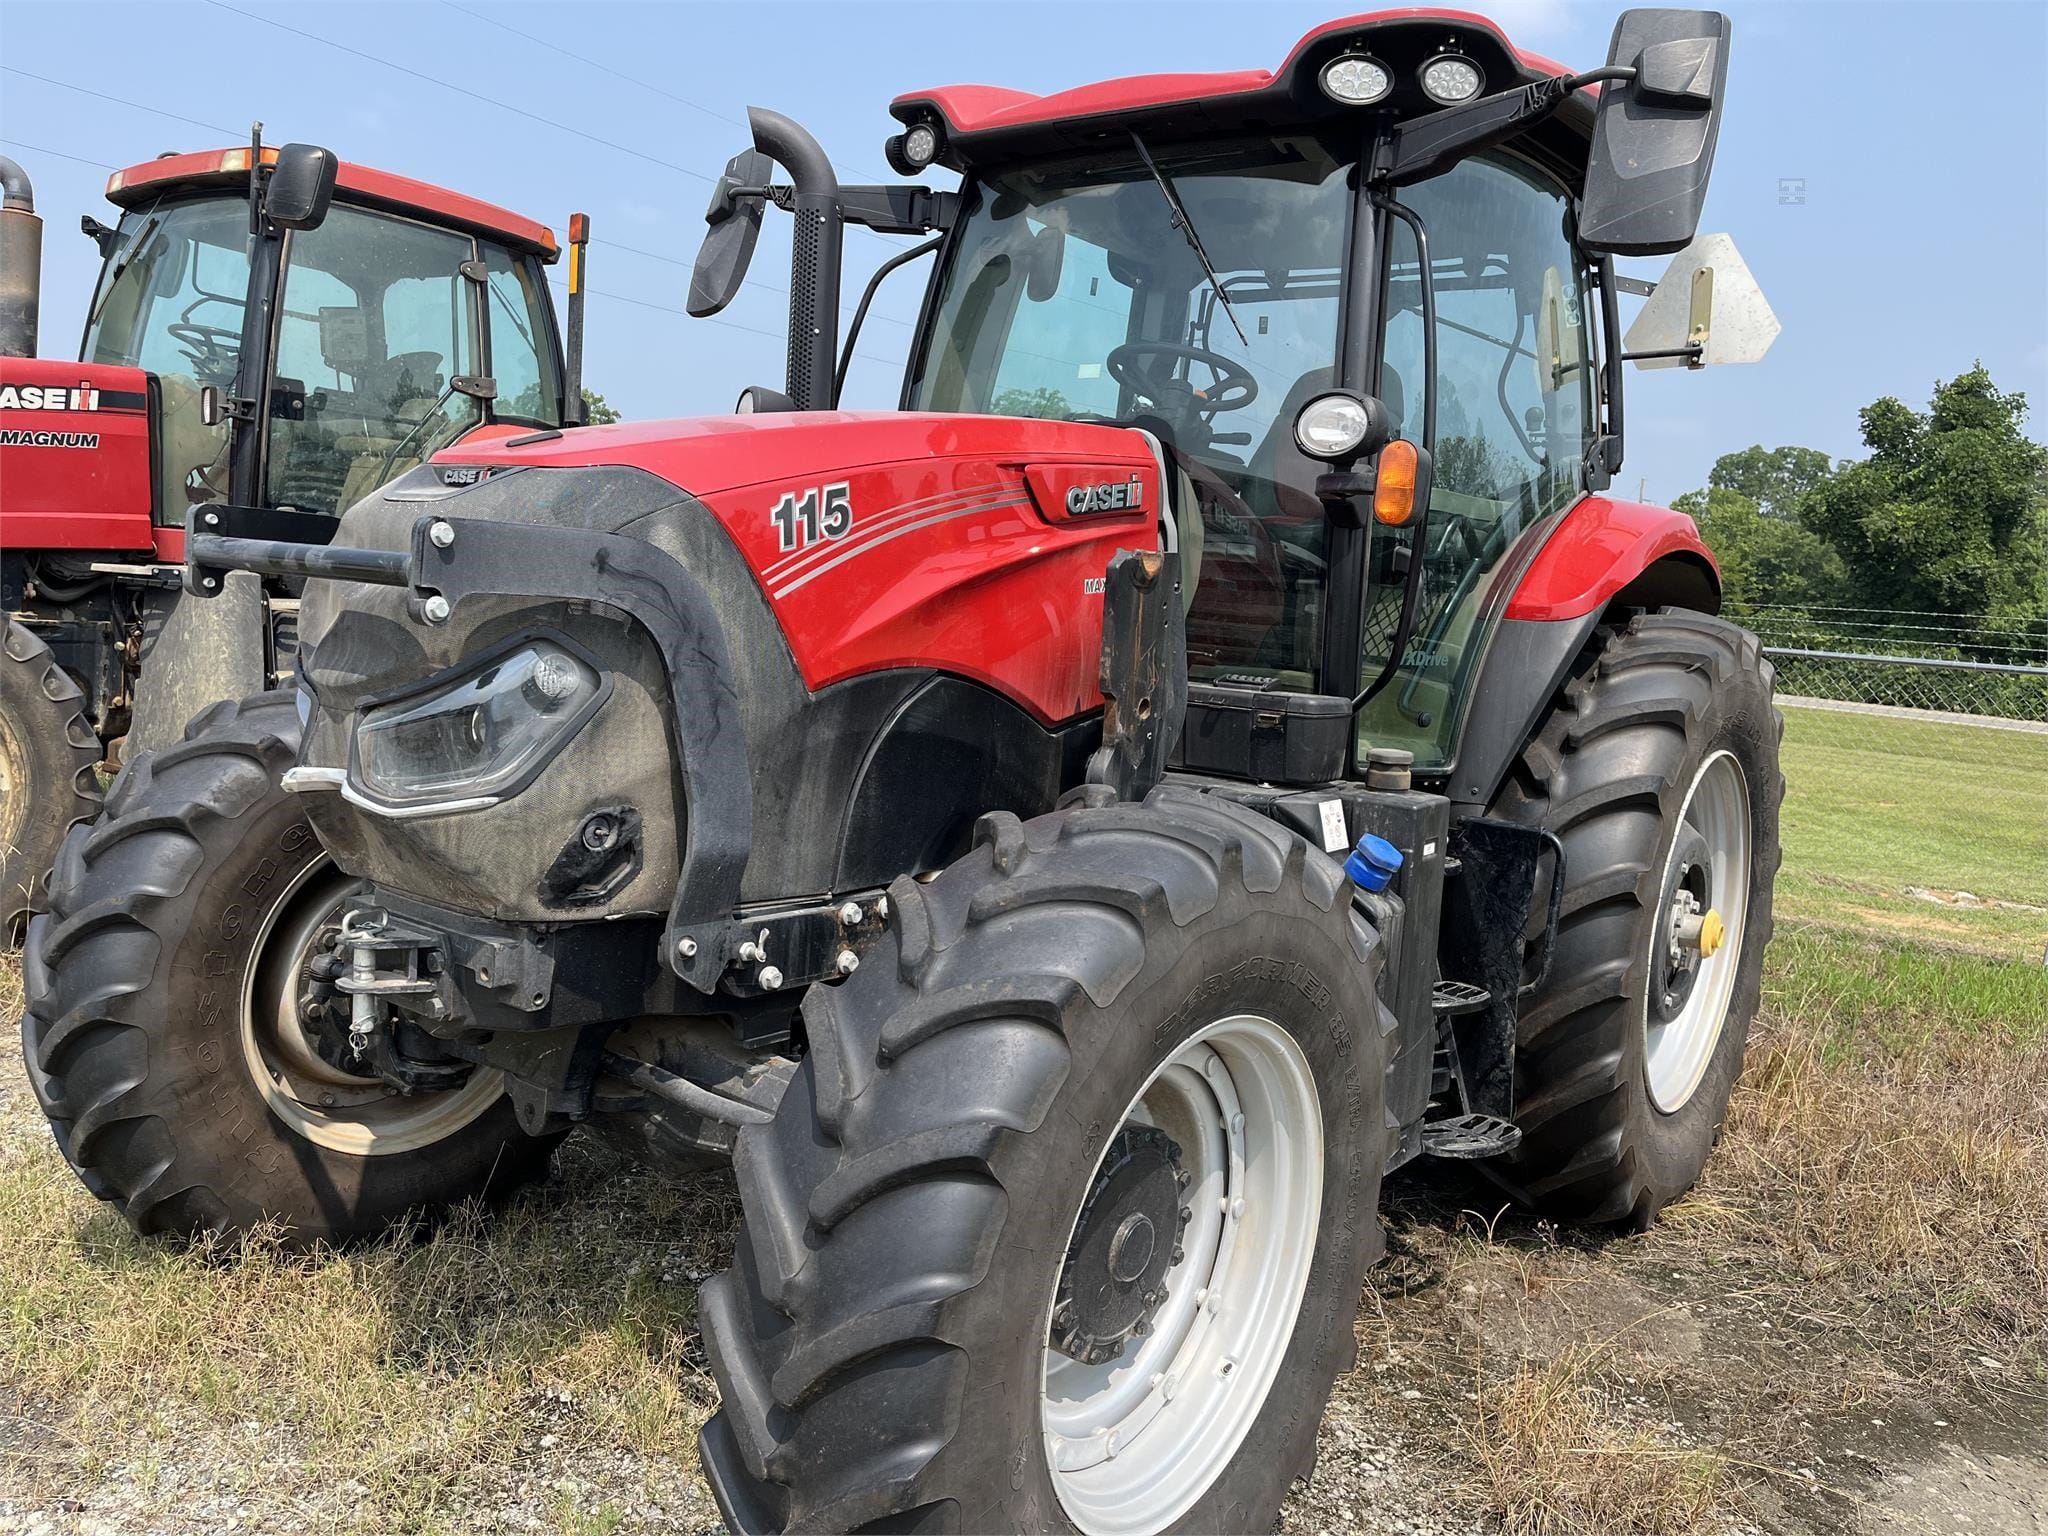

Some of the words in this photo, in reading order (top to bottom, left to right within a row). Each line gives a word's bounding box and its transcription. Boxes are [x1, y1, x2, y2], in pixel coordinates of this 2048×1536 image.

[0, 430, 99, 449] MAGNUM
[444, 469, 477, 484] CASE
[1067, 483, 1126, 514] CASE
[770, 480, 853, 553] 115
